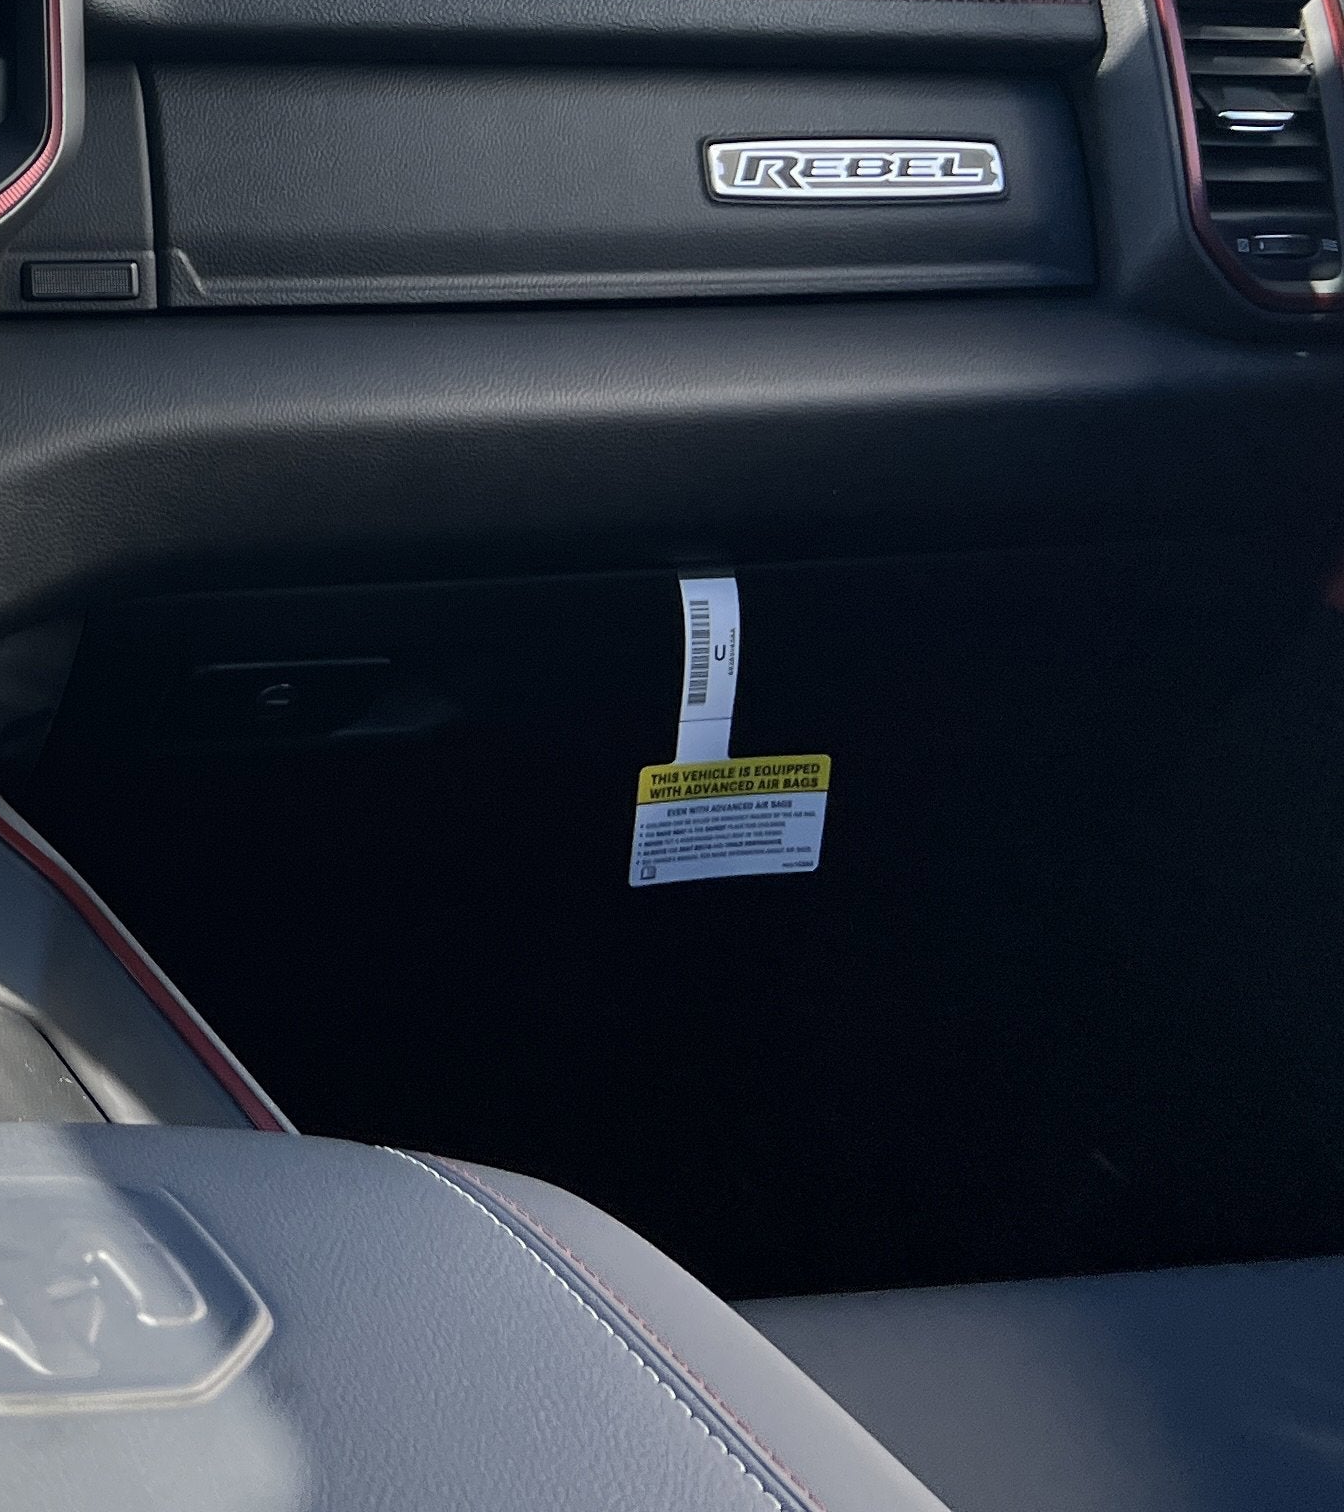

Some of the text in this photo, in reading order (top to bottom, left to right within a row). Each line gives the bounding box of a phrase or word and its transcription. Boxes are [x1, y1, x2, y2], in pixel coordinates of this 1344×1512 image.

[734, 149, 984, 191] REBEL
[650, 762, 821, 786] THIS VEHICLE IS EQUIPPED
[649, 776, 819, 800] WITH ADVANCED AIR BAGS
[709, 801, 755, 814] ADVANCED
